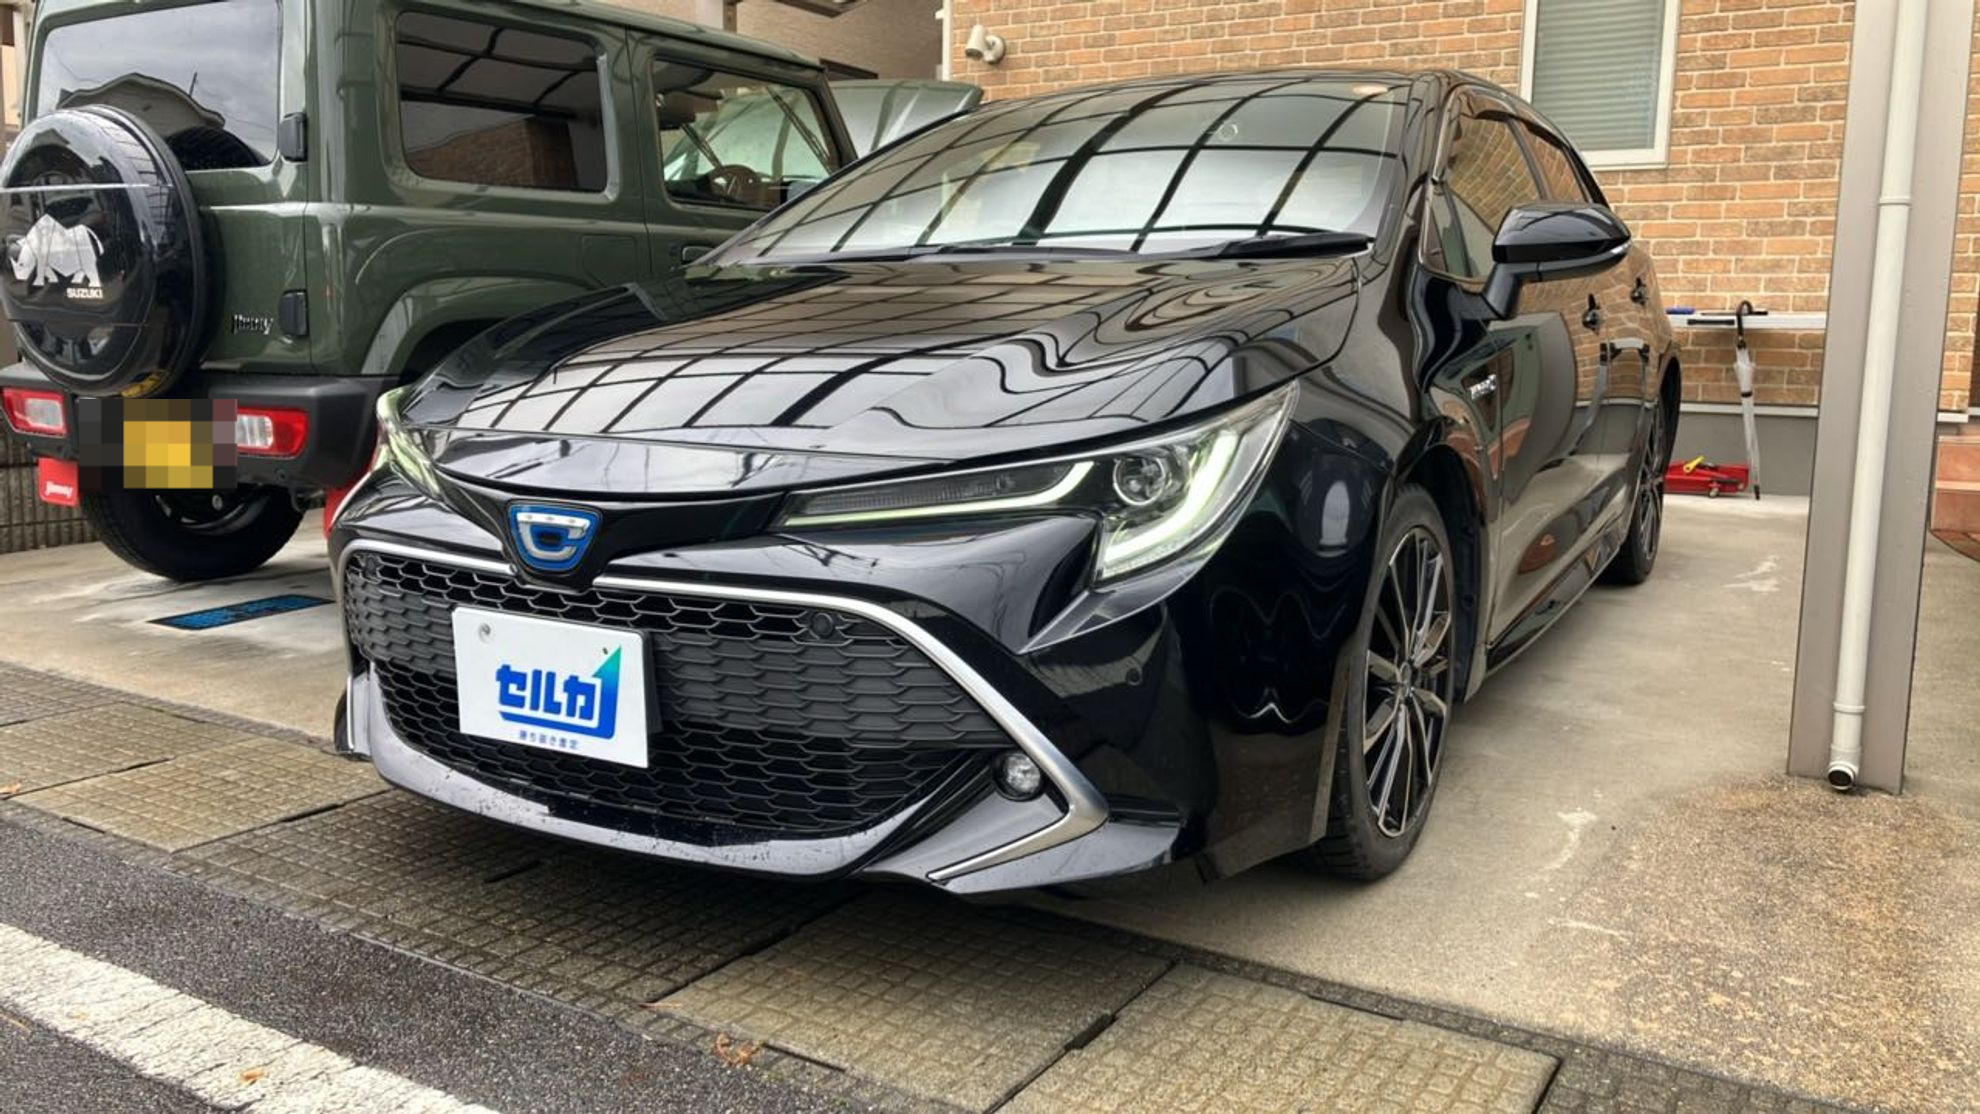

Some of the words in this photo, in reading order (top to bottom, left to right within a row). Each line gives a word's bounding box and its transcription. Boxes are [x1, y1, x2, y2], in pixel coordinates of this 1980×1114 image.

[66, 287, 104, 299] SUZUKI
[496, 664, 597, 722] セルカ
